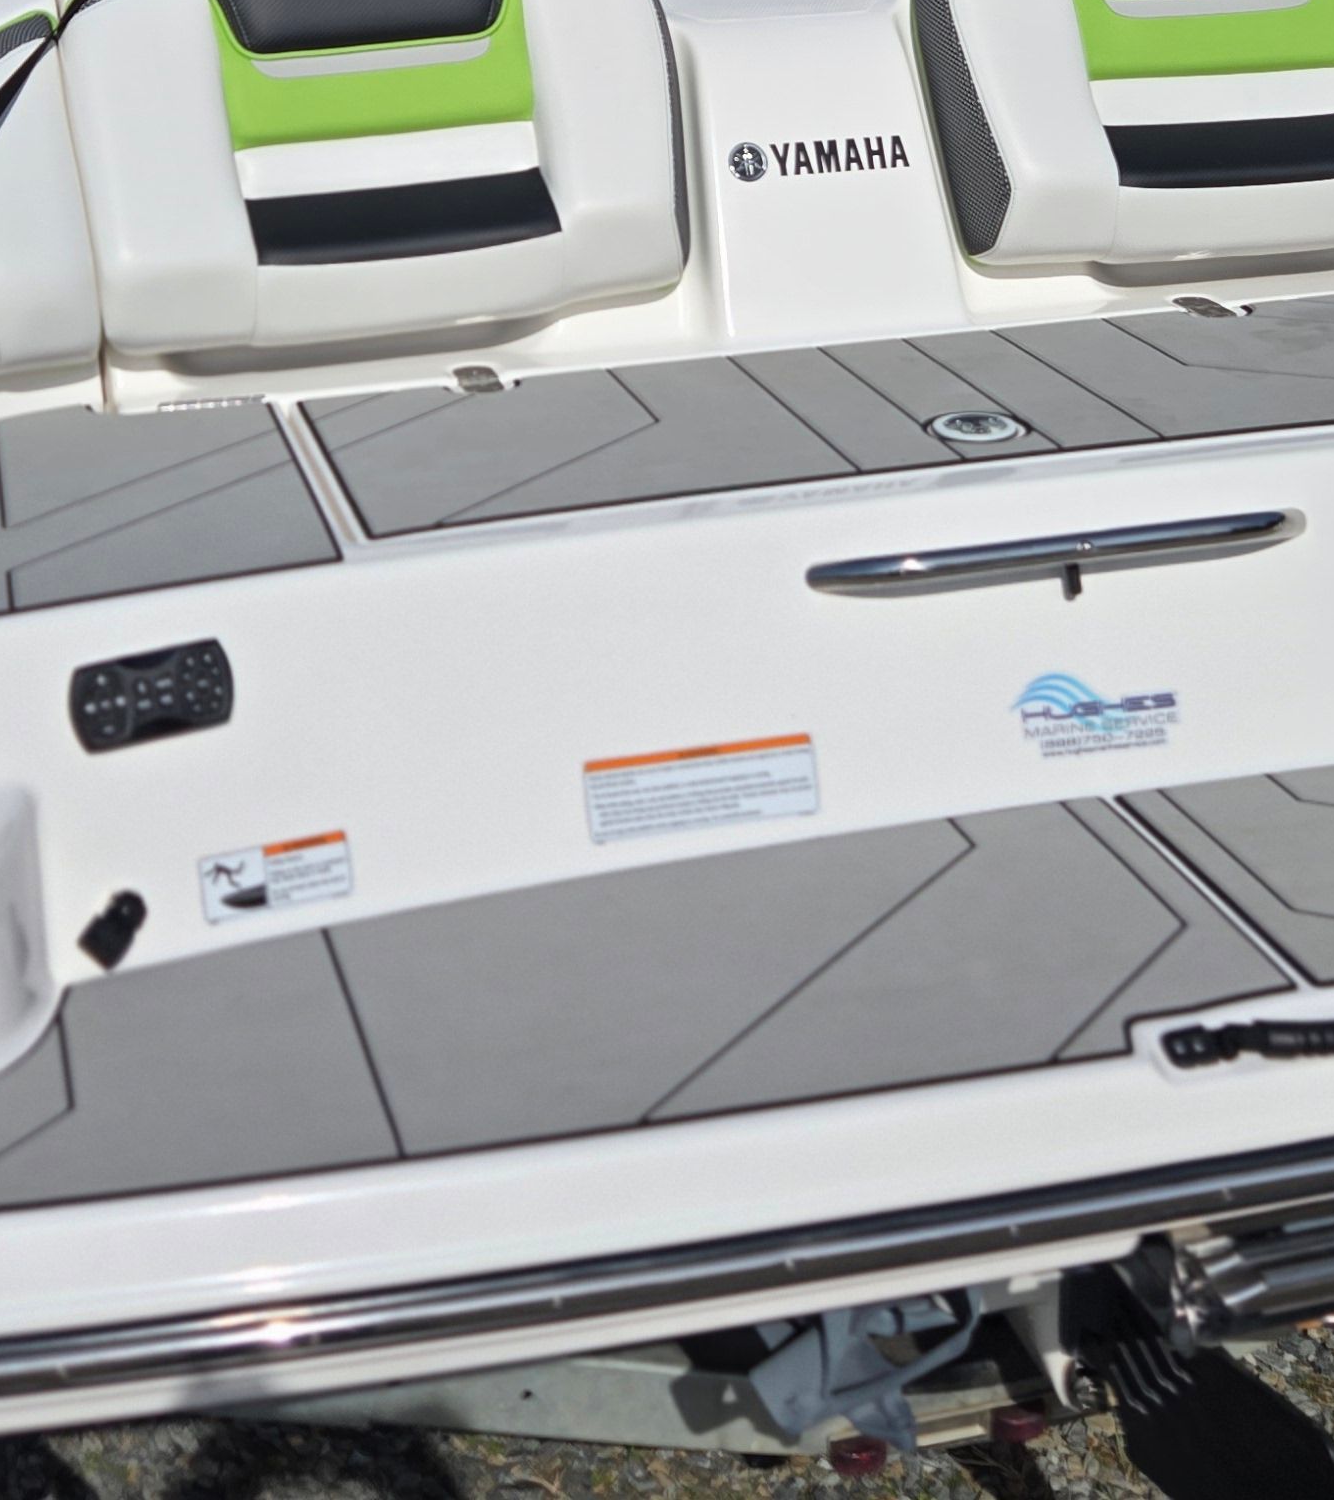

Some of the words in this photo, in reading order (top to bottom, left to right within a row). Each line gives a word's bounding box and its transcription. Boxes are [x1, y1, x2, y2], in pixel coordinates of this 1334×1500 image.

[769, 135, 910, 177] YAMAHA
[1021, 692, 1176, 723] HUGHES
[1024, 720, 1098, 740] MARINE
[1102, 711, 1179, 732] SERVICE
